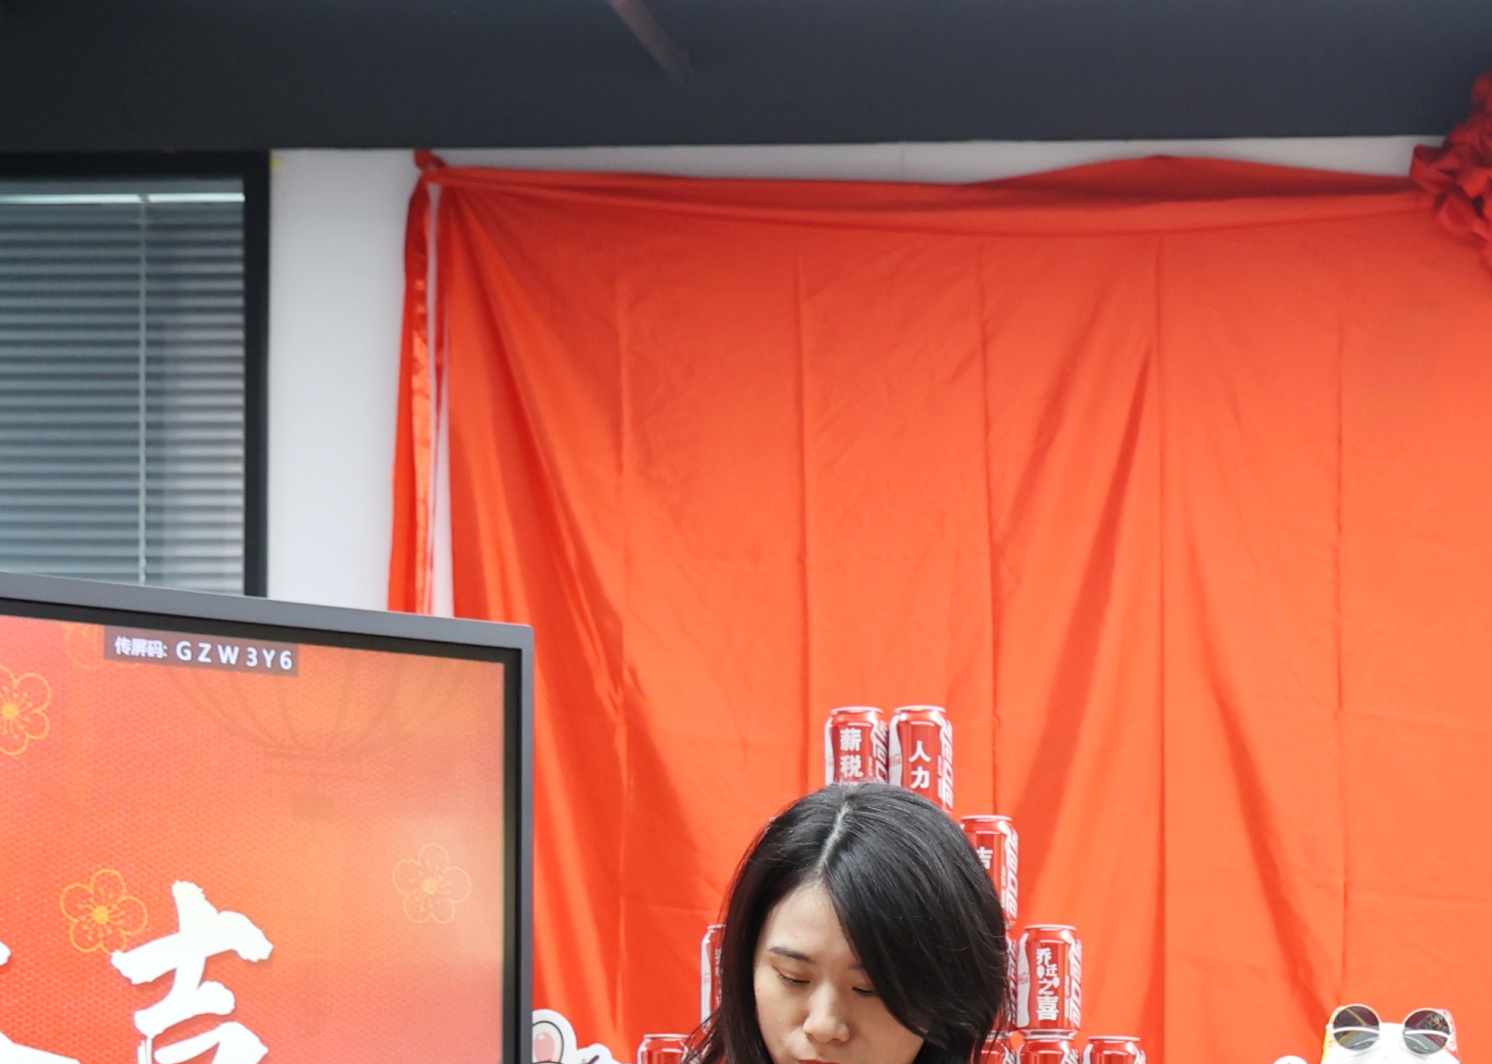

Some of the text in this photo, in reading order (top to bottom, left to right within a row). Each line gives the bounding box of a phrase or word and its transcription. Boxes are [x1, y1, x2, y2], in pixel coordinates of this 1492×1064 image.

[908, 740, 931, 789] 人力
[1035, 947, 1060, 1022] 乔迁之喜
